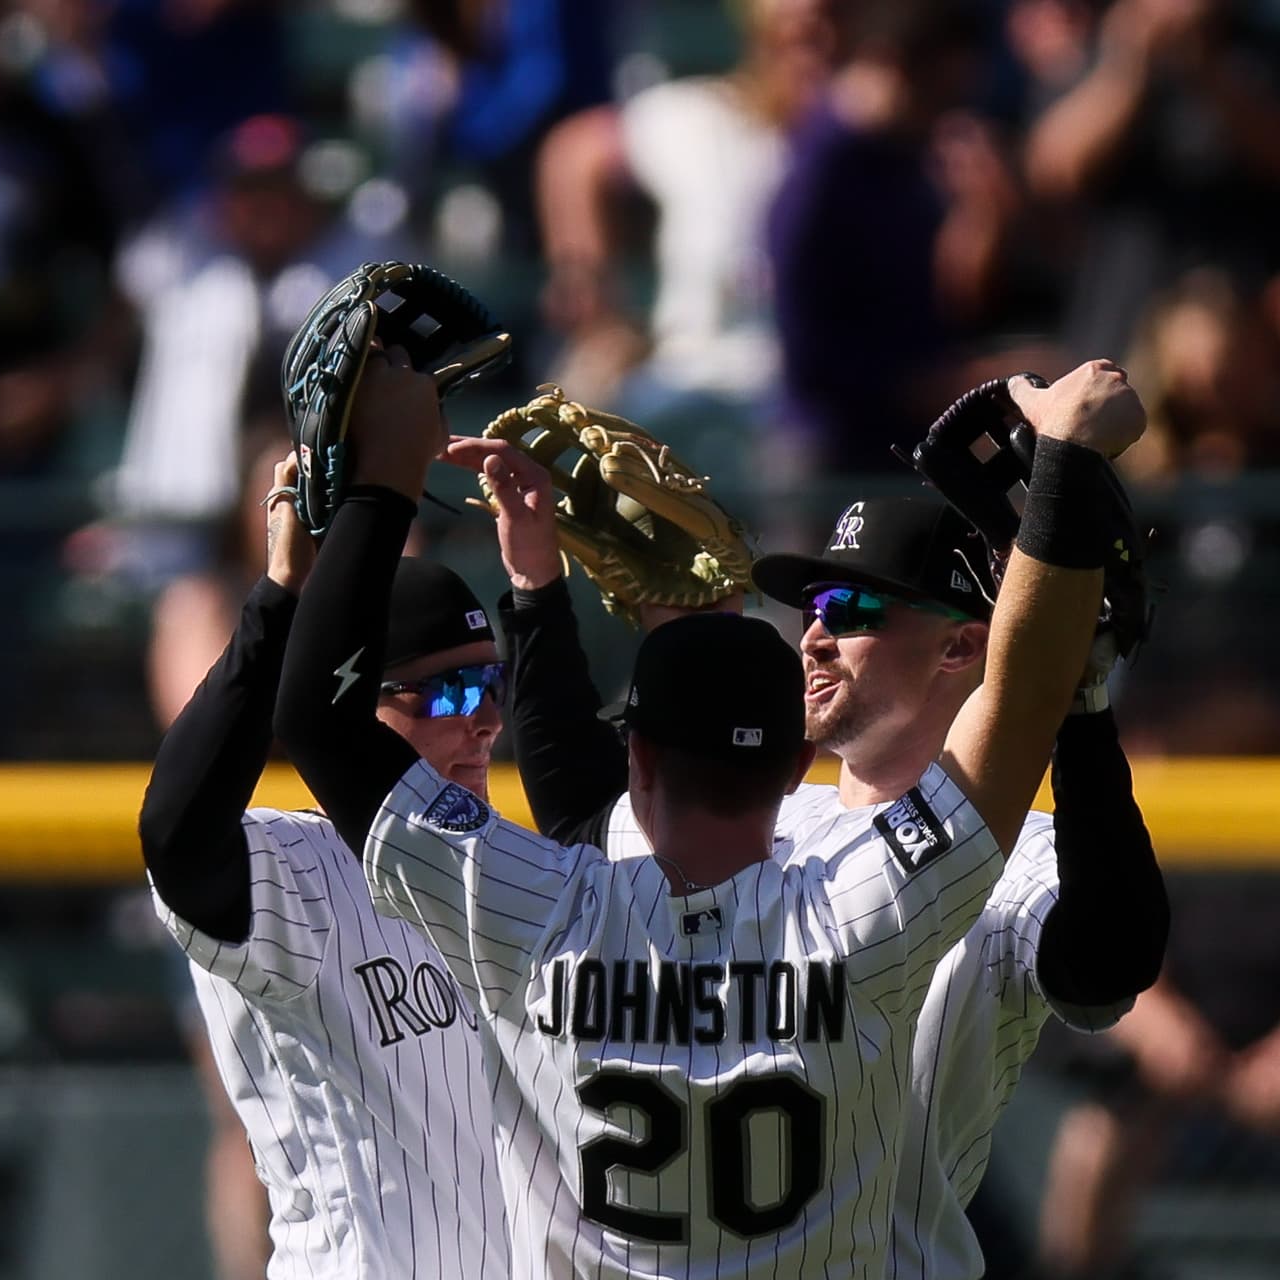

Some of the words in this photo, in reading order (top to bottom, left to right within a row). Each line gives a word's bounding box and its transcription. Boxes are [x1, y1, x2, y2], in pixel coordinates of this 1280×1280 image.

[914, 815, 938, 847] SPACE
[536, 957, 846, 1045] JOHNSTON
[575, 1069, 827, 1245] 20
